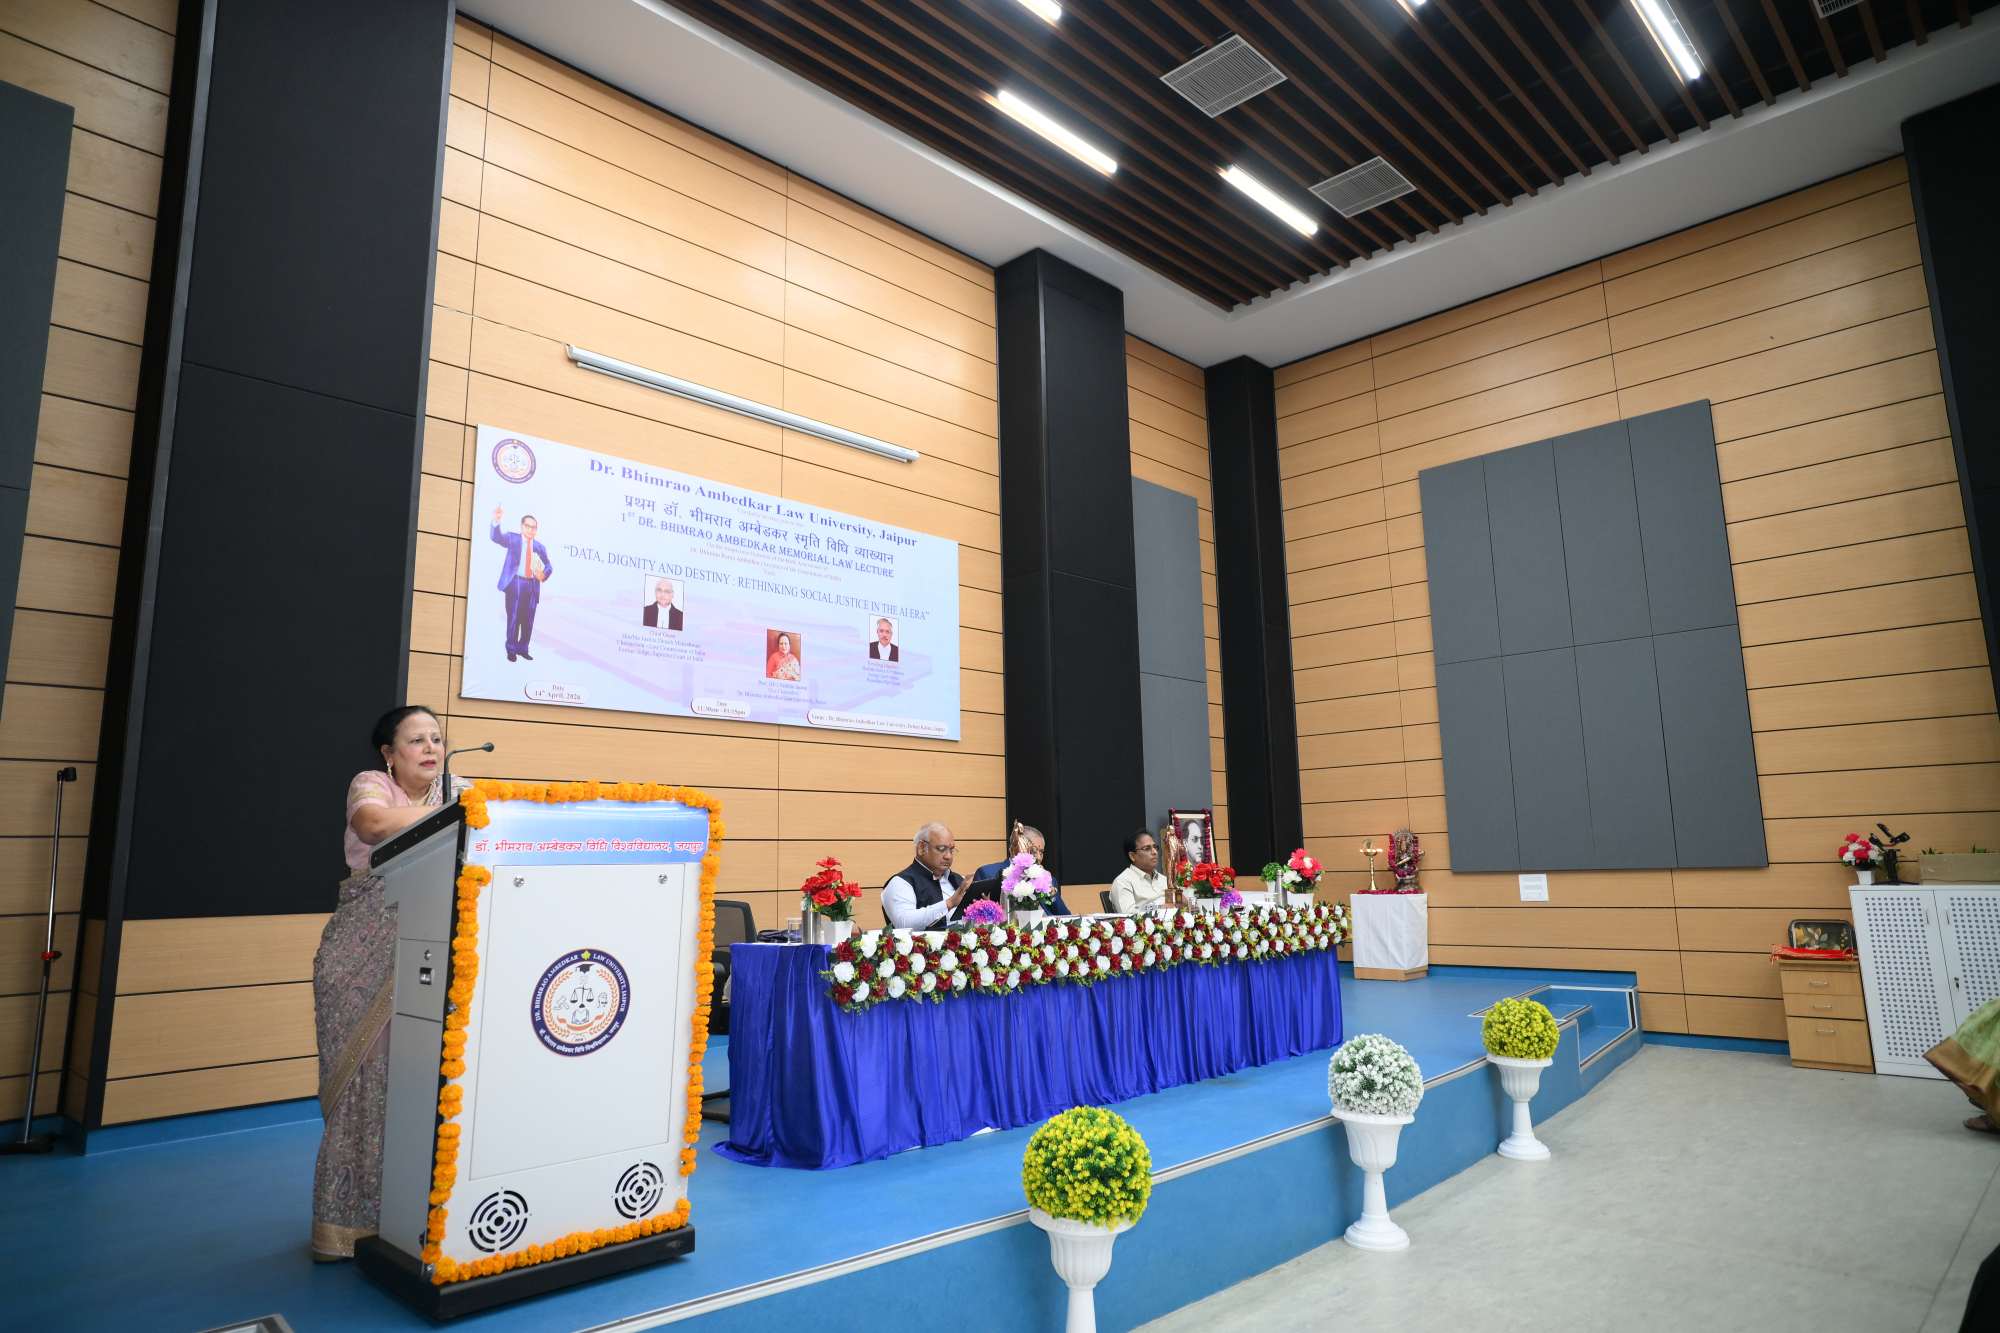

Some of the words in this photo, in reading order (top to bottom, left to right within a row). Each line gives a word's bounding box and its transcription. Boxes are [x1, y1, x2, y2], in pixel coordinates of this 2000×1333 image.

[589, 459, 616, 476] Dr.
[621, 469, 691, 494] Bhimrao
[694, 485, 774, 513] Ambedkar
[776, 504, 805, 521] Law
[809, 512, 876, 538] University,
[879, 529, 918, 547] Jaipur
[624, 494, 656, 513] प्रथम
[663, 501, 682, 519] डॉ.
[689, 507, 732, 529] भीमराव
[794, 531, 820, 550] स्मृति
[826, 536, 849, 555] विधि
[854, 547, 894, 564] व्याख्यान
[638, 515, 657, 529] DR.
[660, 520, 713, 540] BHIMRAO
[715, 534, 776, 554] AMBEDKAR
[778, 546, 830, 565] MEMORIAL
[832, 556, 853, 569] LAW
[855, 561, 895, 578] LECTURE
[608, 552, 656, 571] DIGNITY
[658, 561, 682, 577] AND
[685, 567, 731, 585] DESTINY
[738, 576, 799, 598] RETHINKING
[800, 587, 834, 604] SOCIAL
[835, 595, 869, 611] JUSTICE
[871, 599, 880, 612] IN
[881, 602, 898, 616] THE
[473, 839, 491, 853] डॉ.
[494, 839, 533, 853] भीमराव
[536, 839, 583, 853] अम्बेडकर
[586, 838, 608, 852] विधि
[675, 840, 703, 855] जयपुर
[547, 954, 579, 979] AMBEDKAR
